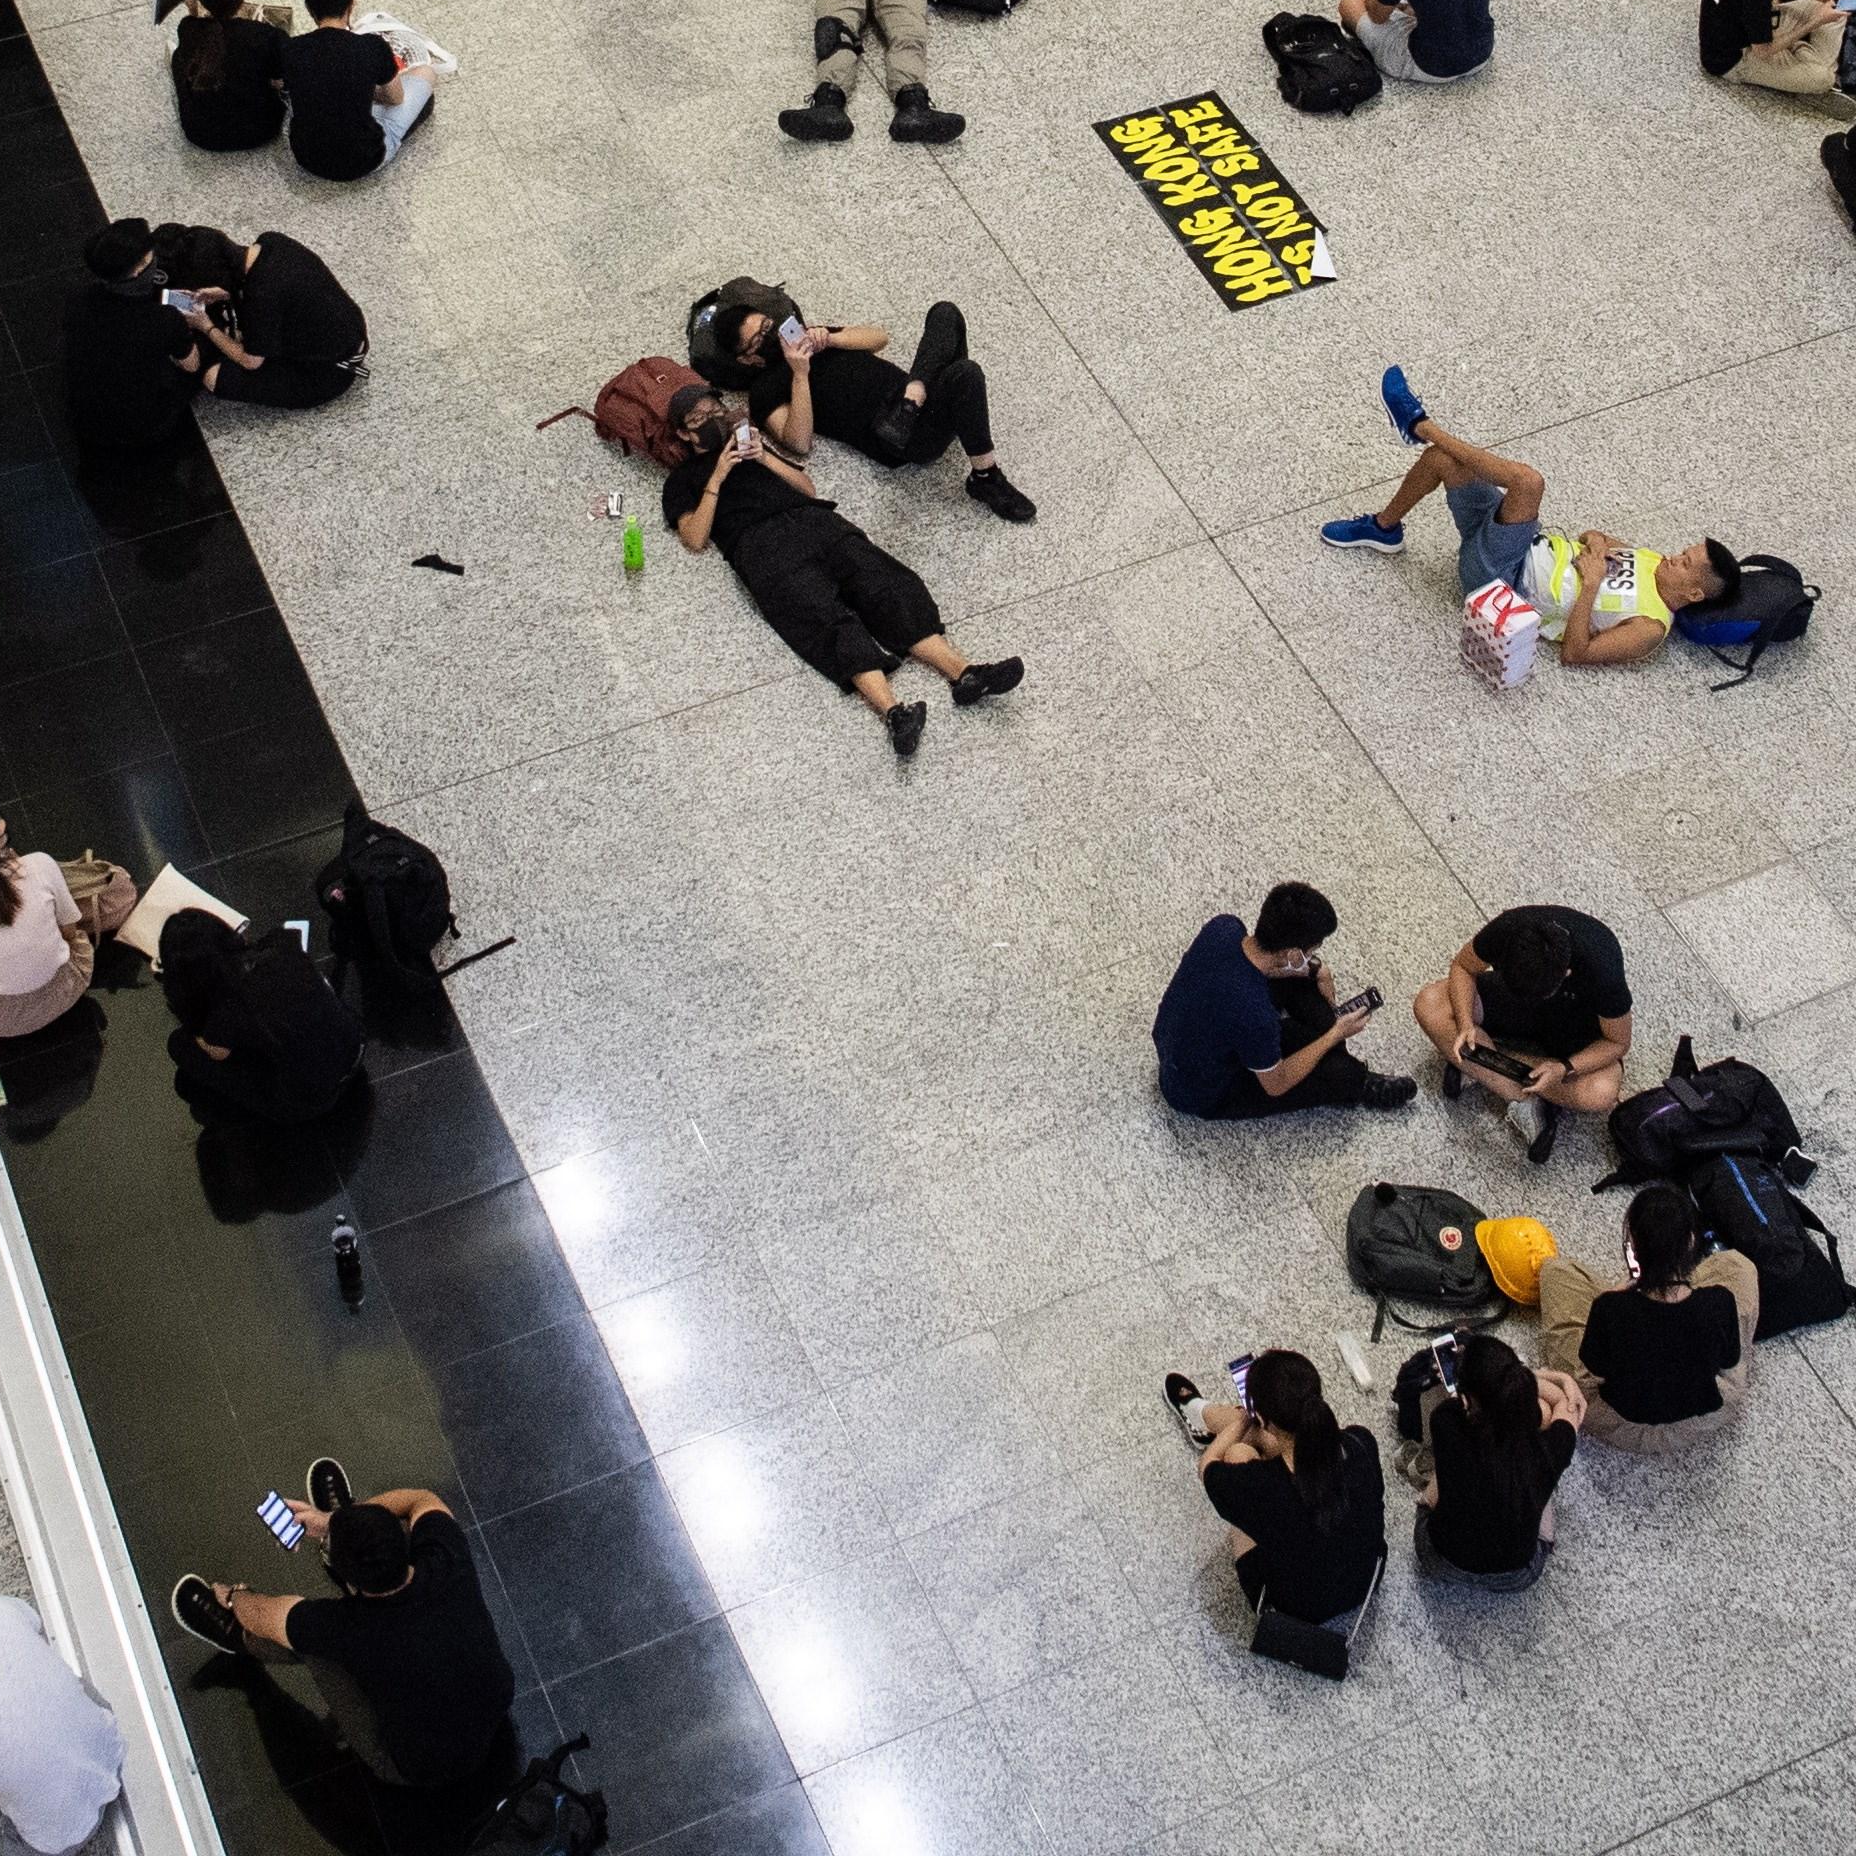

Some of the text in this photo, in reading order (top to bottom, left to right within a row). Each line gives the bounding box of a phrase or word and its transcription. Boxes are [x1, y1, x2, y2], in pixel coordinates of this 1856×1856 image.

[1169, 100, 1260, 178] SAFE
[1110, 116, 1293, 302] HONG KONG
[1231, 181, 1314, 240] NOT
